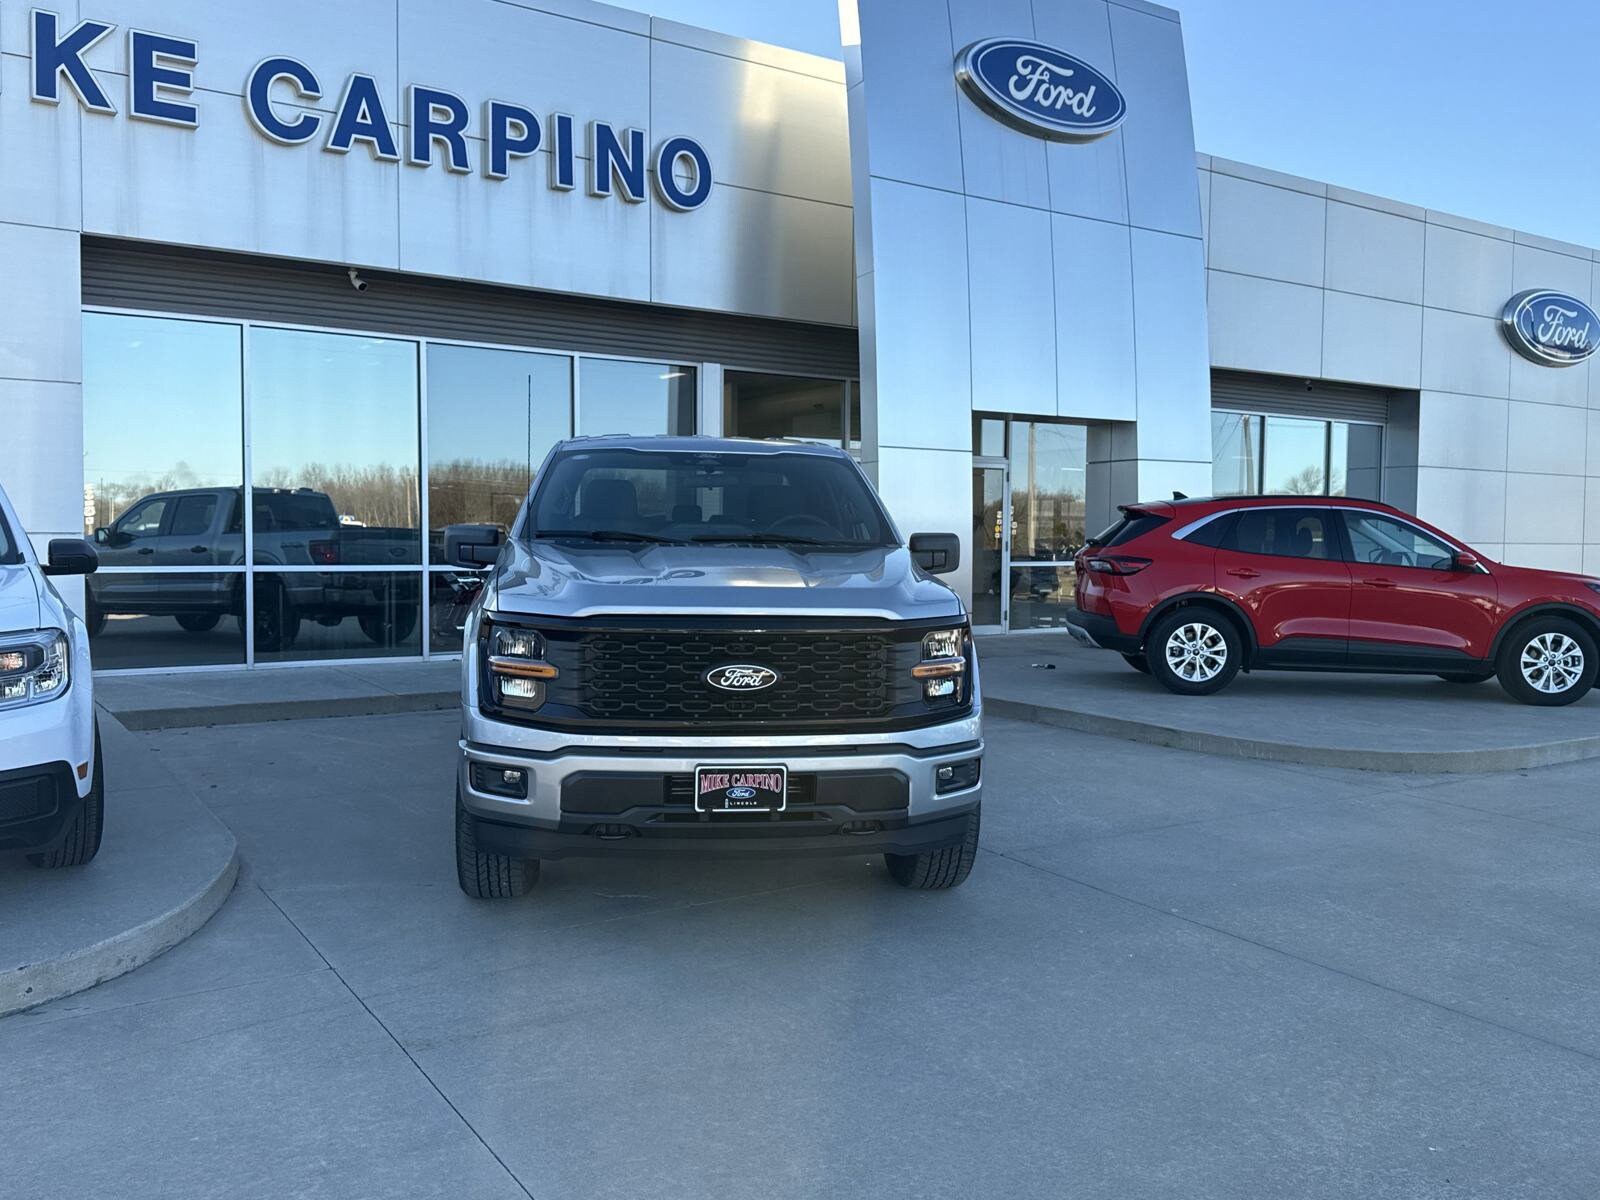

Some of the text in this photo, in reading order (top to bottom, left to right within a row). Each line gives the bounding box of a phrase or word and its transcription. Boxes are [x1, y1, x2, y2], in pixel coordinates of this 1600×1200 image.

[1008, 55, 1096, 118] Ford
[244, 54, 714, 213] CARPINO
[1537, 305, 1590, 349] Ford
[720, 668, 763, 686] Ford
[700, 773, 782, 795] MIKE CARPINO
[731, 789, 750, 797] Ford
